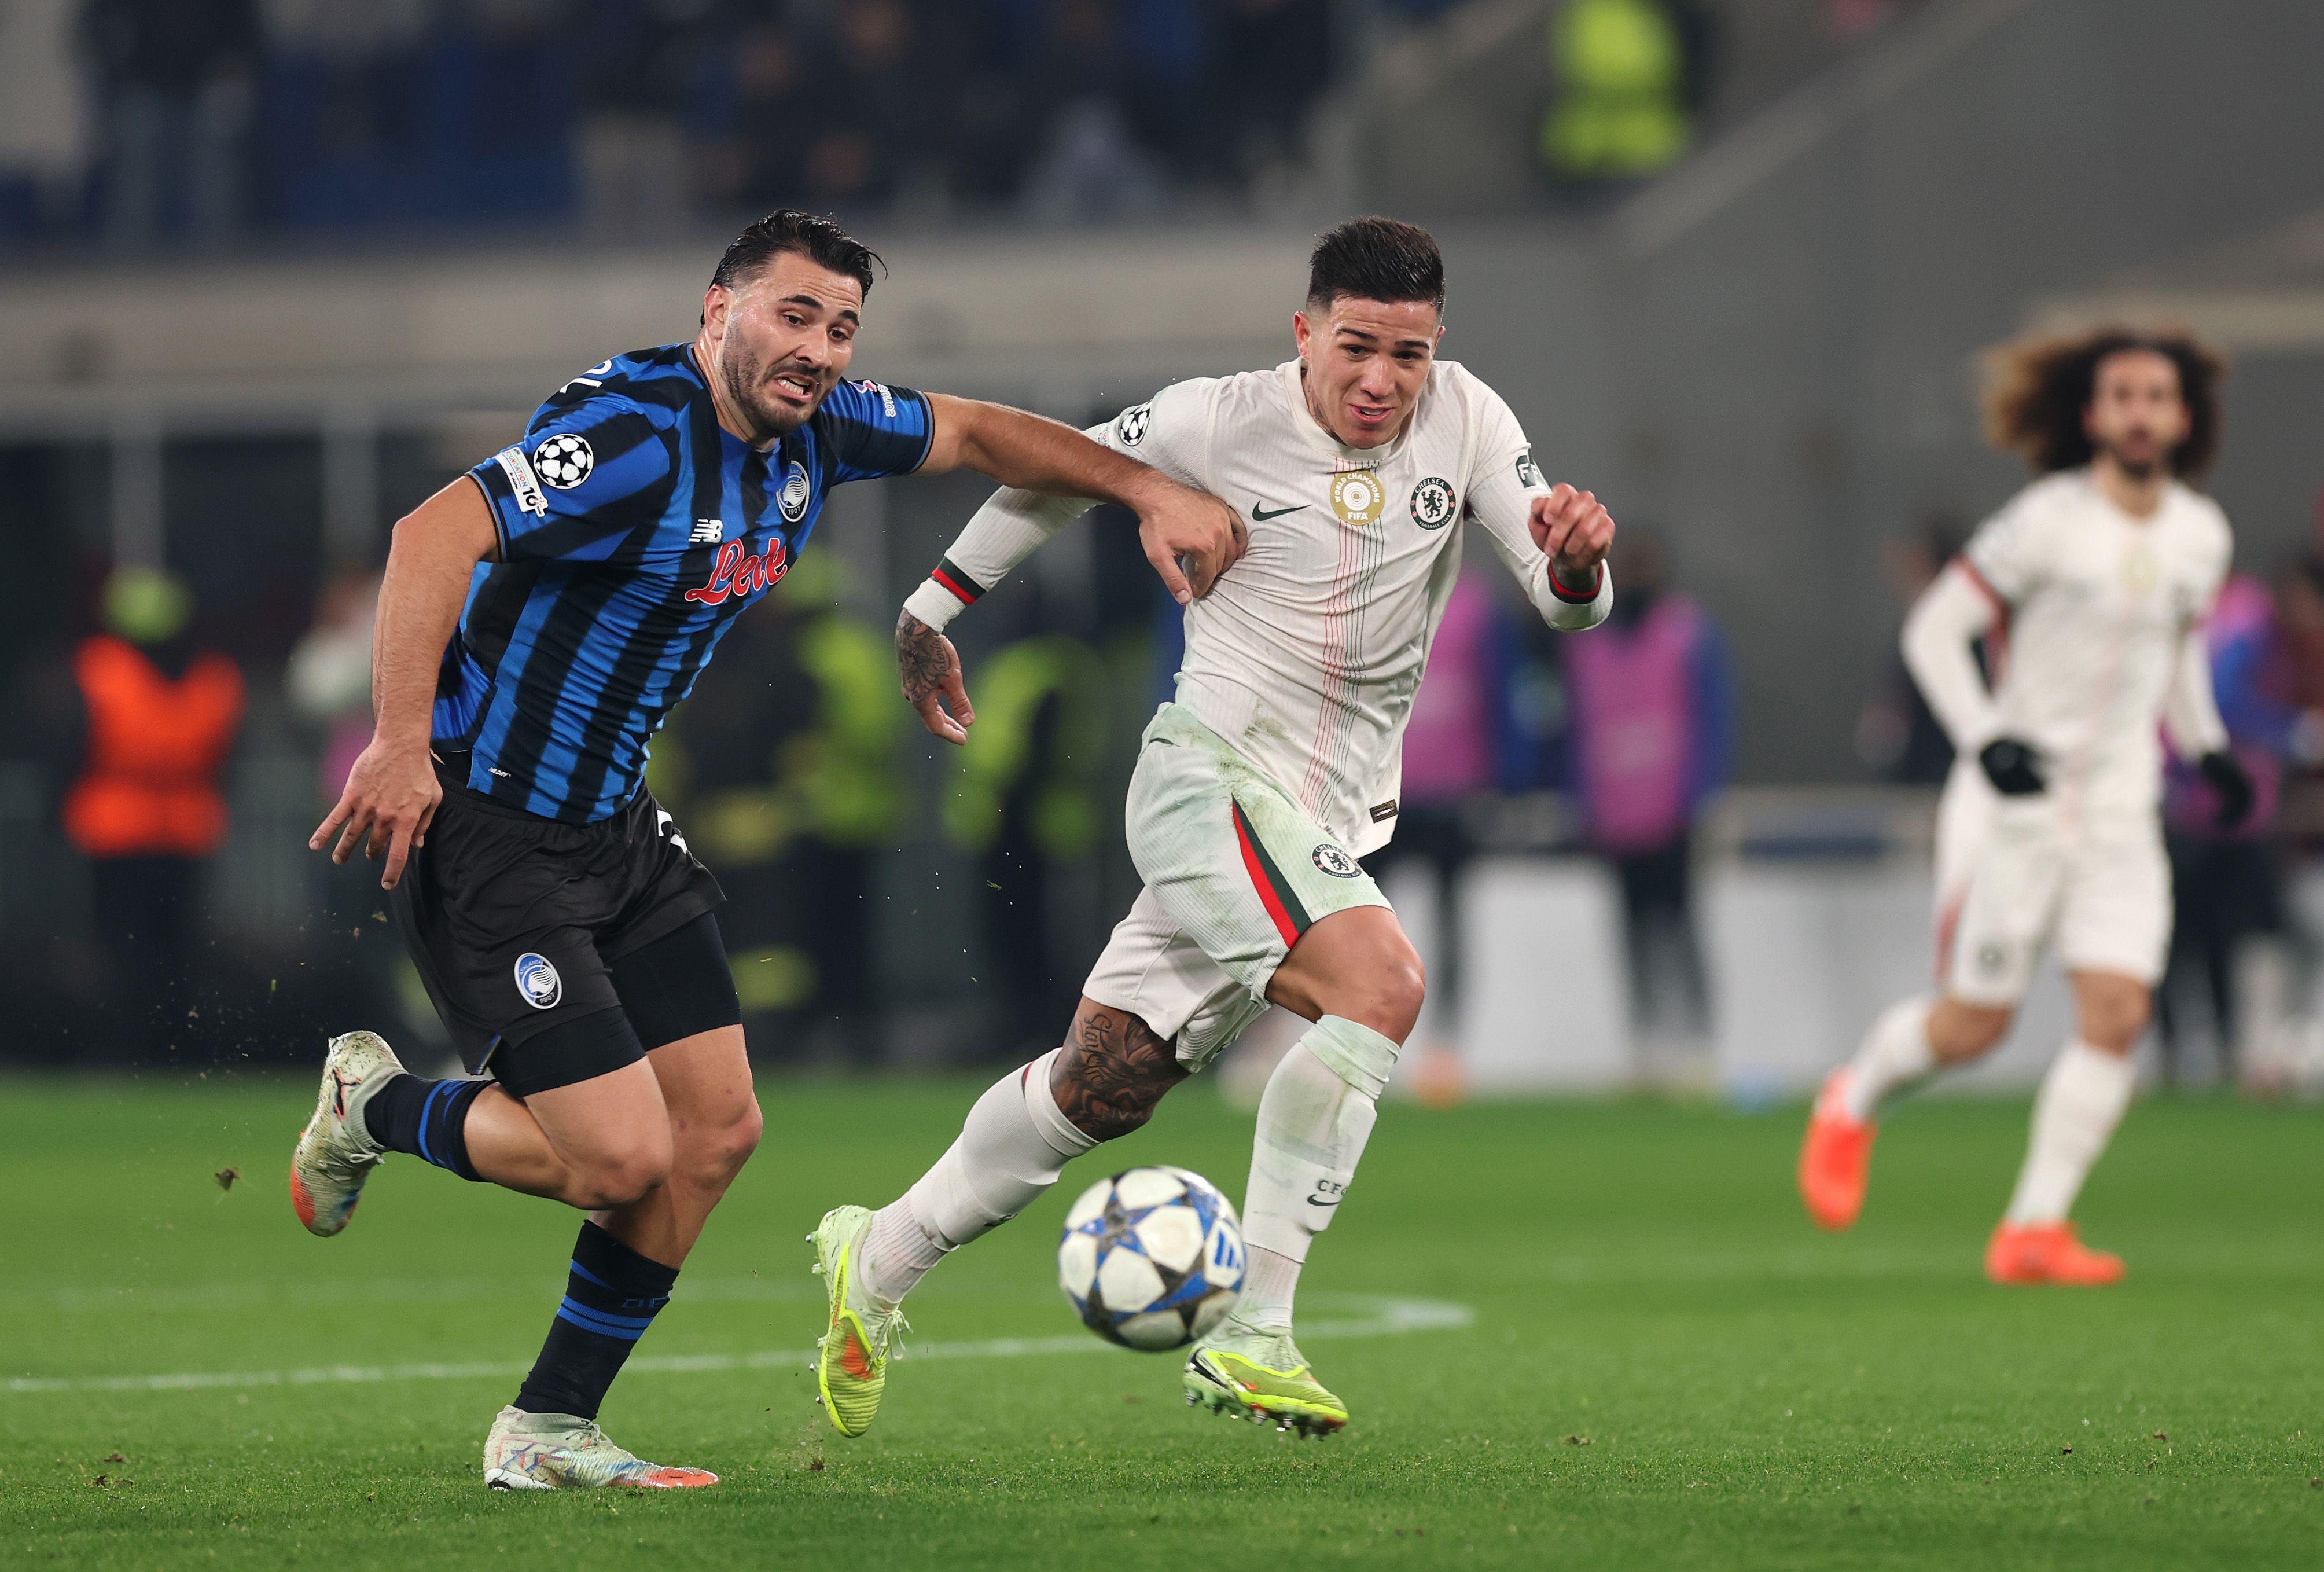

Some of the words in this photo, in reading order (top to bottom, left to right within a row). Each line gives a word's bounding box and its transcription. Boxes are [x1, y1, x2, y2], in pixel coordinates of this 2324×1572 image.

[1334, 477, 1347, 503] WORLD
[1347, 473, 1380, 503] CHAMPIONS
[1415, 478, 1445, 493] CHELSEA
[788, 506, 800, 515] 1907
[1347, 512, 1369, 520] FIFA
[1441, 514, 1451, 524] CLUB
